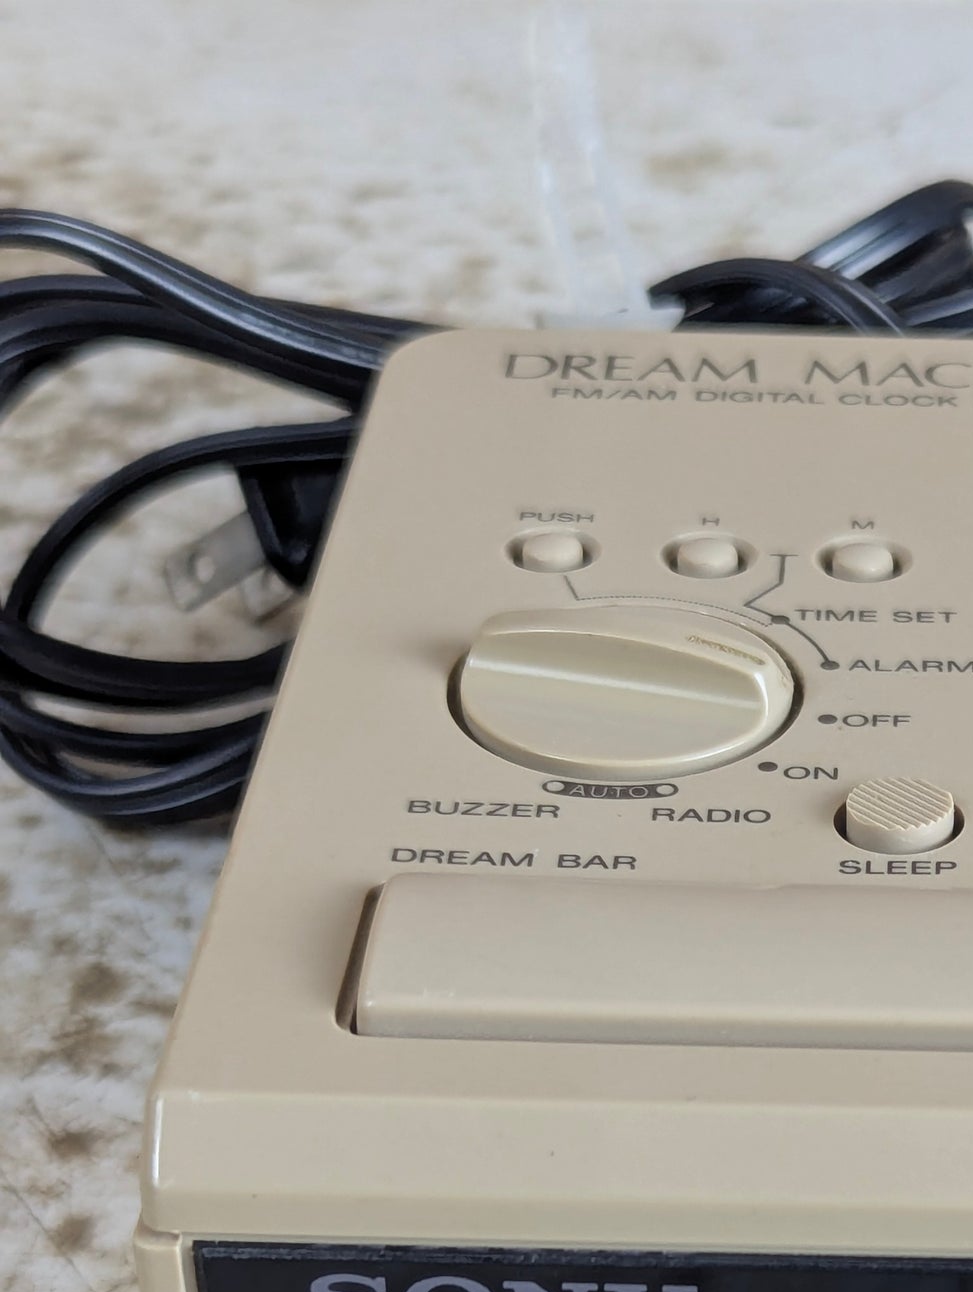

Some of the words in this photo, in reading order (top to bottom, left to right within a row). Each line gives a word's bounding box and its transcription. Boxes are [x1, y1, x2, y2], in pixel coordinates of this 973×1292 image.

[504, 352, 759, 384] DREAM
[551, 387, 678, 402] FM/AM
[695, 391, 825, 406] DIGITAL
[838, 395, 958, 409] CLOCK
[519, 512, 594, 523] PUSH
[702, 517, 719, 526] H
[851, 520, 875, 530] M
[795, 608, 877, 623] TIME
[893, 611, 957, 624] SET
[842, 714, 911, 728] OFF
[783, 766, 839, 781] ON
[569, 783, 648, 799] AUTO
[407, 800, 561, 818] BUZZER
[651, 807, 771, 824] RADIO
[391, 848, 534, 867] DREAM
[557, 854, 637, 870] BAR
[839, 859, 957, 876] SLEEP
